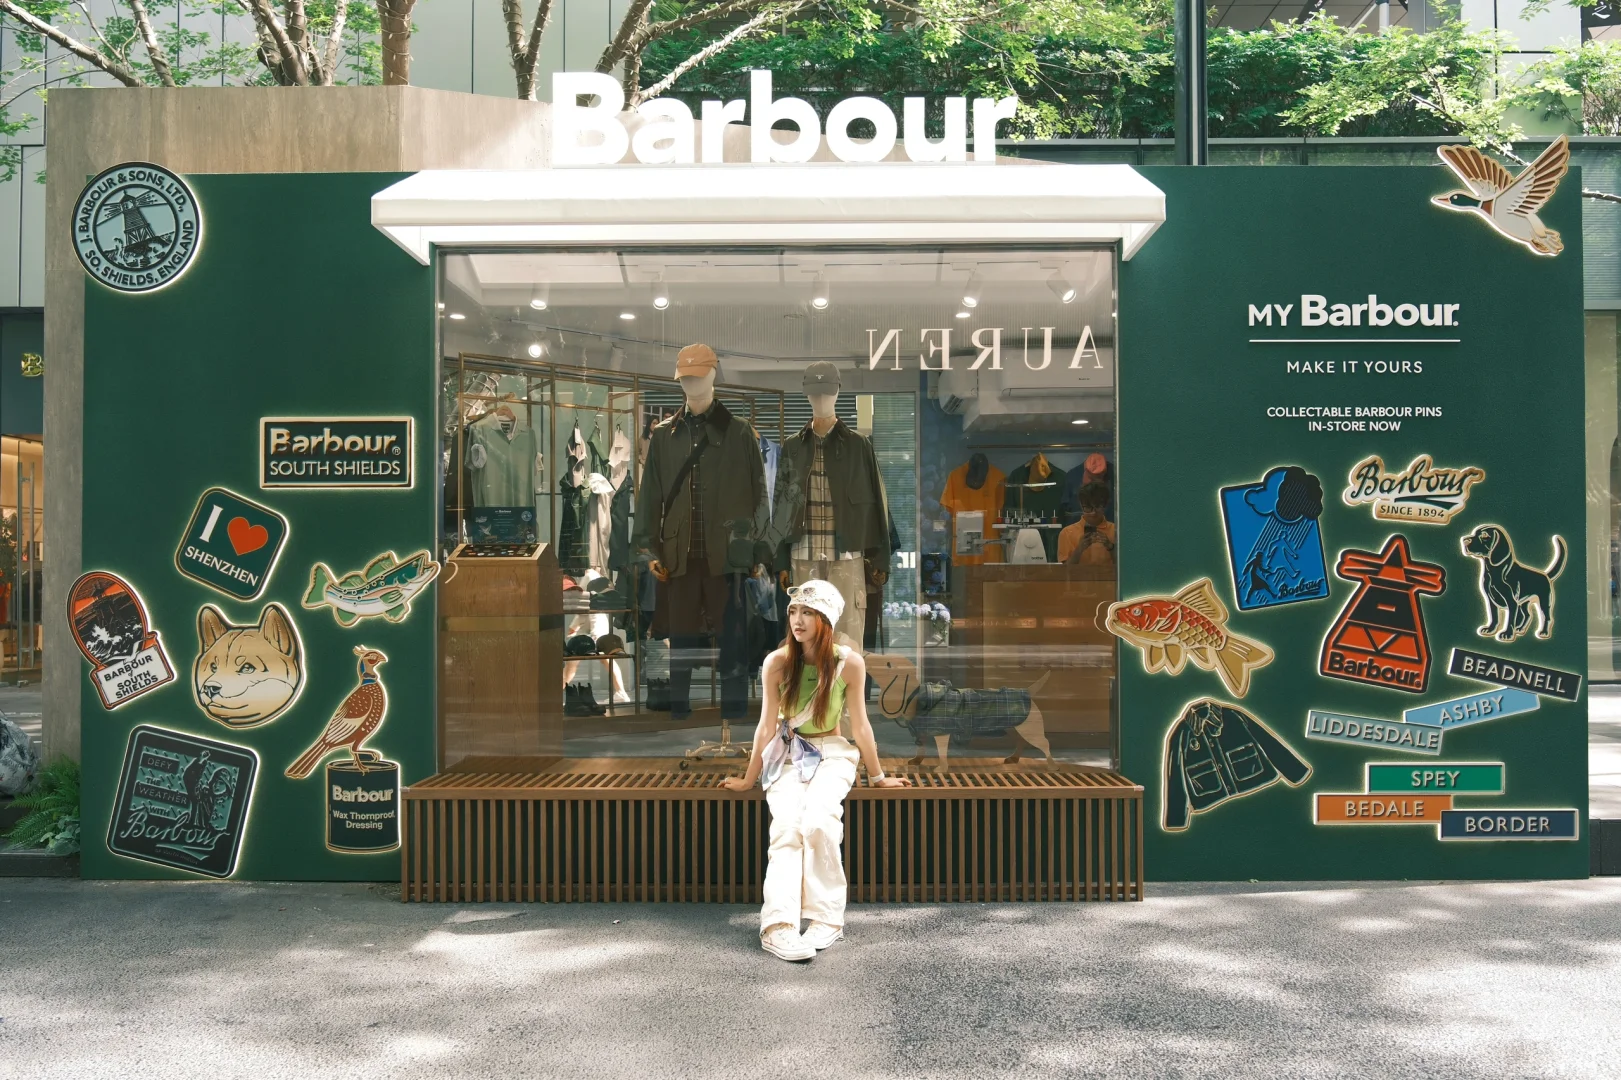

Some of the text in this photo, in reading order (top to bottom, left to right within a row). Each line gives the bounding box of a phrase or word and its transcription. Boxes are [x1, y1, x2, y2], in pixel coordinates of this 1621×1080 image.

[552, 69, 1018, 163] Barbour
[78, 177, 116, 233] BARBOUR
[117, 172, 127, 183] &
[128, 170, 165, 189] SONS,
[85, 219, 194, 286] SO. SHIELDS, ENGLAND
[1248, 303, 1294, 327] MY
[1286, 360, 1423, 374] MAKE IT YOURS
[1266, 406, 1443, 418] COLLECTABLE BARBOUR PINS
[1308, 421, 1401, 432] IN-STORE NOW
[270, 460, 401, 476] SOUTH SHIELDS
[1350, 459, 1479, 499] Barbour
[1380, 505, 1445, 518] SINCE 1894
[199, 504, 224, 543] I
[184, 545, 259, 587] SHENZHEN
[104, 654, 153, 682] BARBOUR
[1462, 656, 1566, 694] BEADNELL
[115, 675, 158, 699] SHIELDS
[117, 670, 151, 691] SOUTH
[1438, 695, 1505, 725] ASHBY
[1310, 715, 1440, 749] LIDDESDALE
[147, 757, 173, 769] DEFY
[1411, 770, 1461, 788] SPEY
[139, 786, 187, 805] WEATHER
[332, 784, 394, 802] Barbour
[332, 809, 348, 820] Wax
[1345, 800, 1424, 818] BEDALE
[120, 805, 231, 850] Barbour
[345, 820, 383, 830] Dressing
[1465, 816, 1551, 834] BORDER
